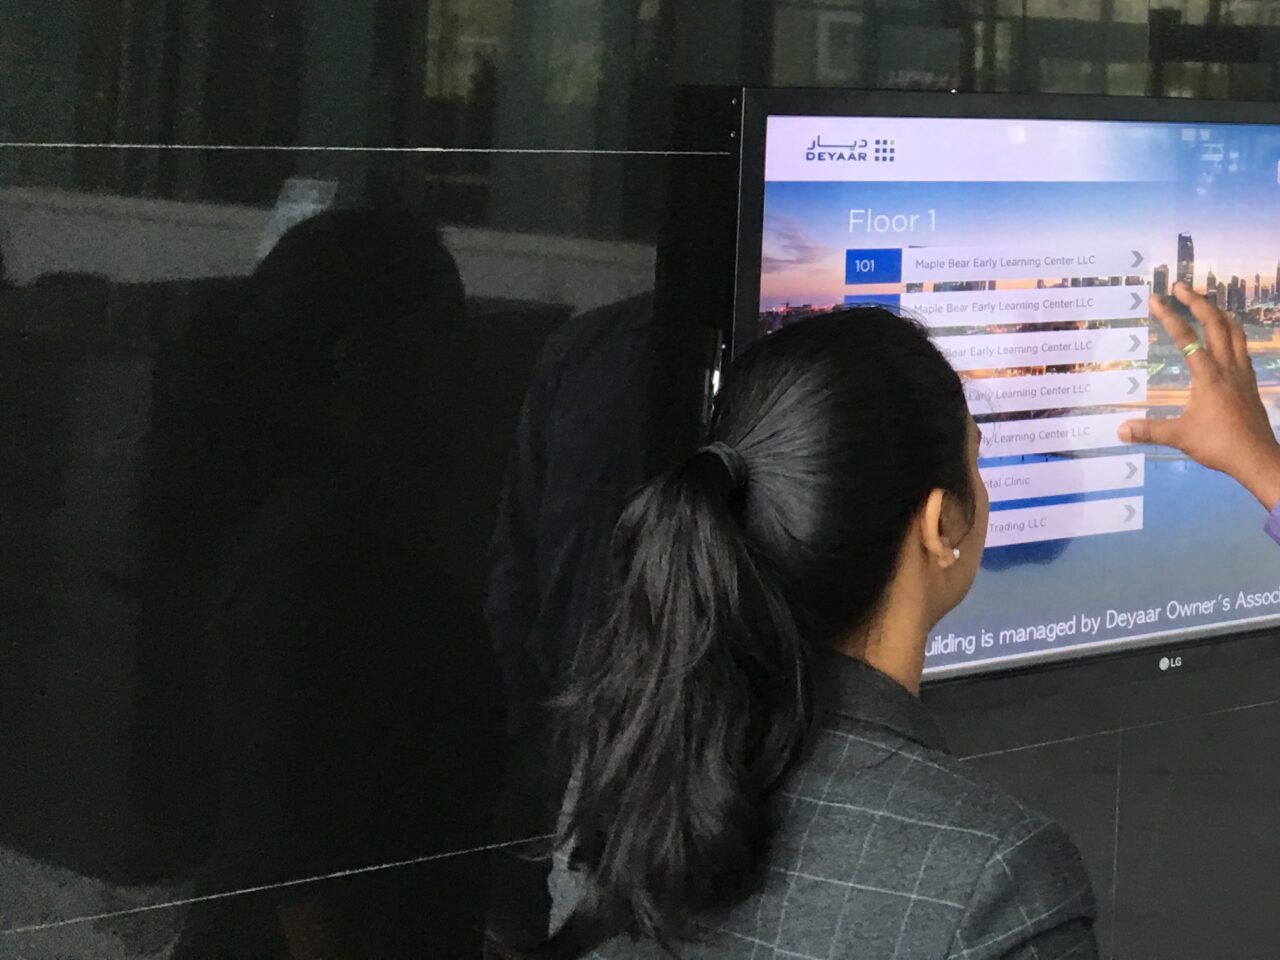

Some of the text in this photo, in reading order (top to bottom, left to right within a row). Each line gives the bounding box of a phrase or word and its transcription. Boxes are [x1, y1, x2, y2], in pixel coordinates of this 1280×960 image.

[805, 151, 867, 161] DEYAAR
[849, 208, 936, 233] Floor 1
[855, 259, 875, 273] 101
[915, 255, 1096, 271] Maple Bear Early Learning Center LLC
[914, 298, 1094, 315] Maple Bear Early Learning Center LLC
[946, 341, 1093, 358] Bear Early Learning Center LLC
[968, 384, 1091, 403] Early Learning Center LLC
[994, 432, 1036, 444] Learning
[1038, 430, 1069, 439] Center
[1071, 427, 1090, 437] LLC
[985, 476, 1030, 488] ntal Clinic
[990, 518, 1047, 533] Trading LLC
[924, 633, 976, 656] uilding
[981, 629, 994, 648] is
[999, 615, 1076, 645] managed
[1081, 613, 1101, 634] by
[1106, 606, 1161, 631] Deyaar
[1170, 657, 1182, 667] LG
